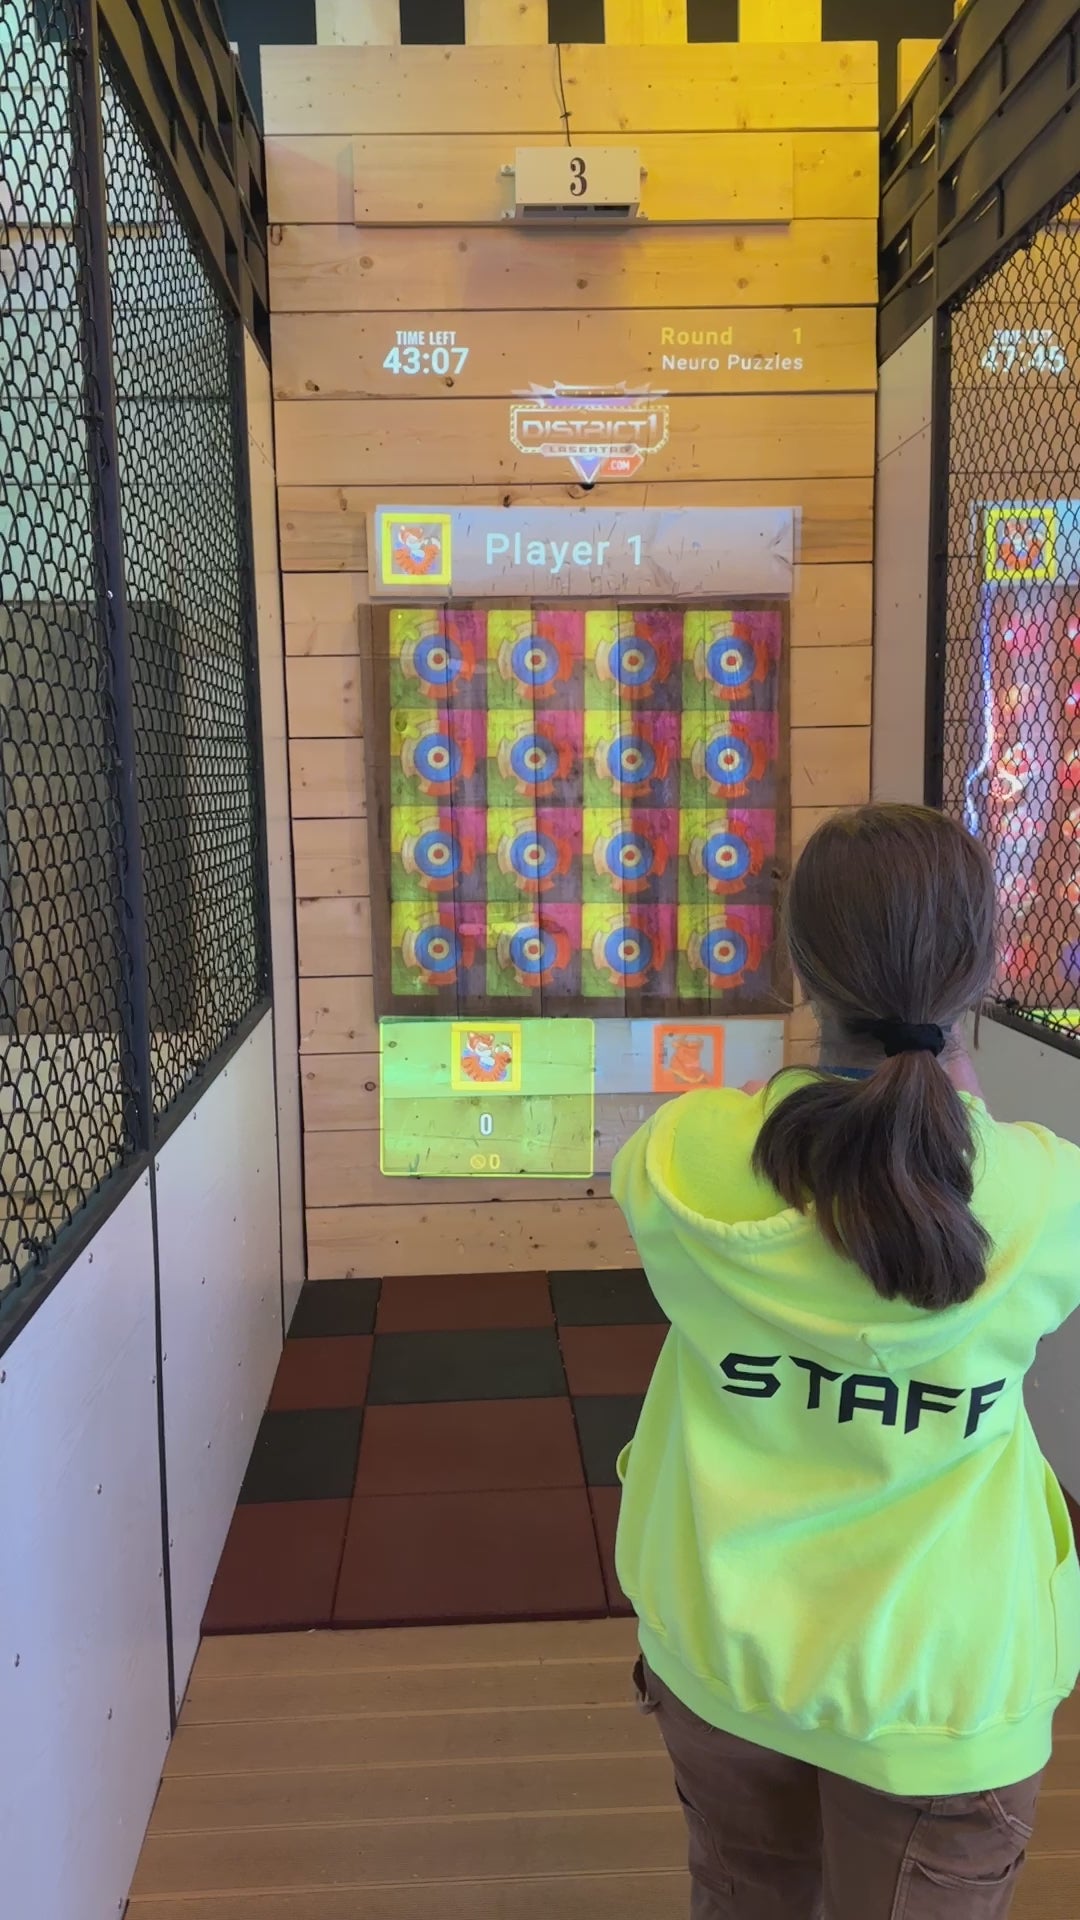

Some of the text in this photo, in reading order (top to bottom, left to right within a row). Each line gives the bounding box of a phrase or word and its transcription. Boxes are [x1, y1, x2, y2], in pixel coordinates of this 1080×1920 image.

[570, 157, 587, 196] 3
[396, 331, 456, 345] TIME LEFT
[661, 326, 802, 345] Round 1
[383, 347, 469, 375] 43:07
[661, 354, 803, 371] Neuro Puzzles
[486, 532, 642, 574] Player 1
[480, 1113, 493, 1136] 0
[490, 1154, 500, 1170] 0
[719, 1352, 1007, 1439] STAFF
